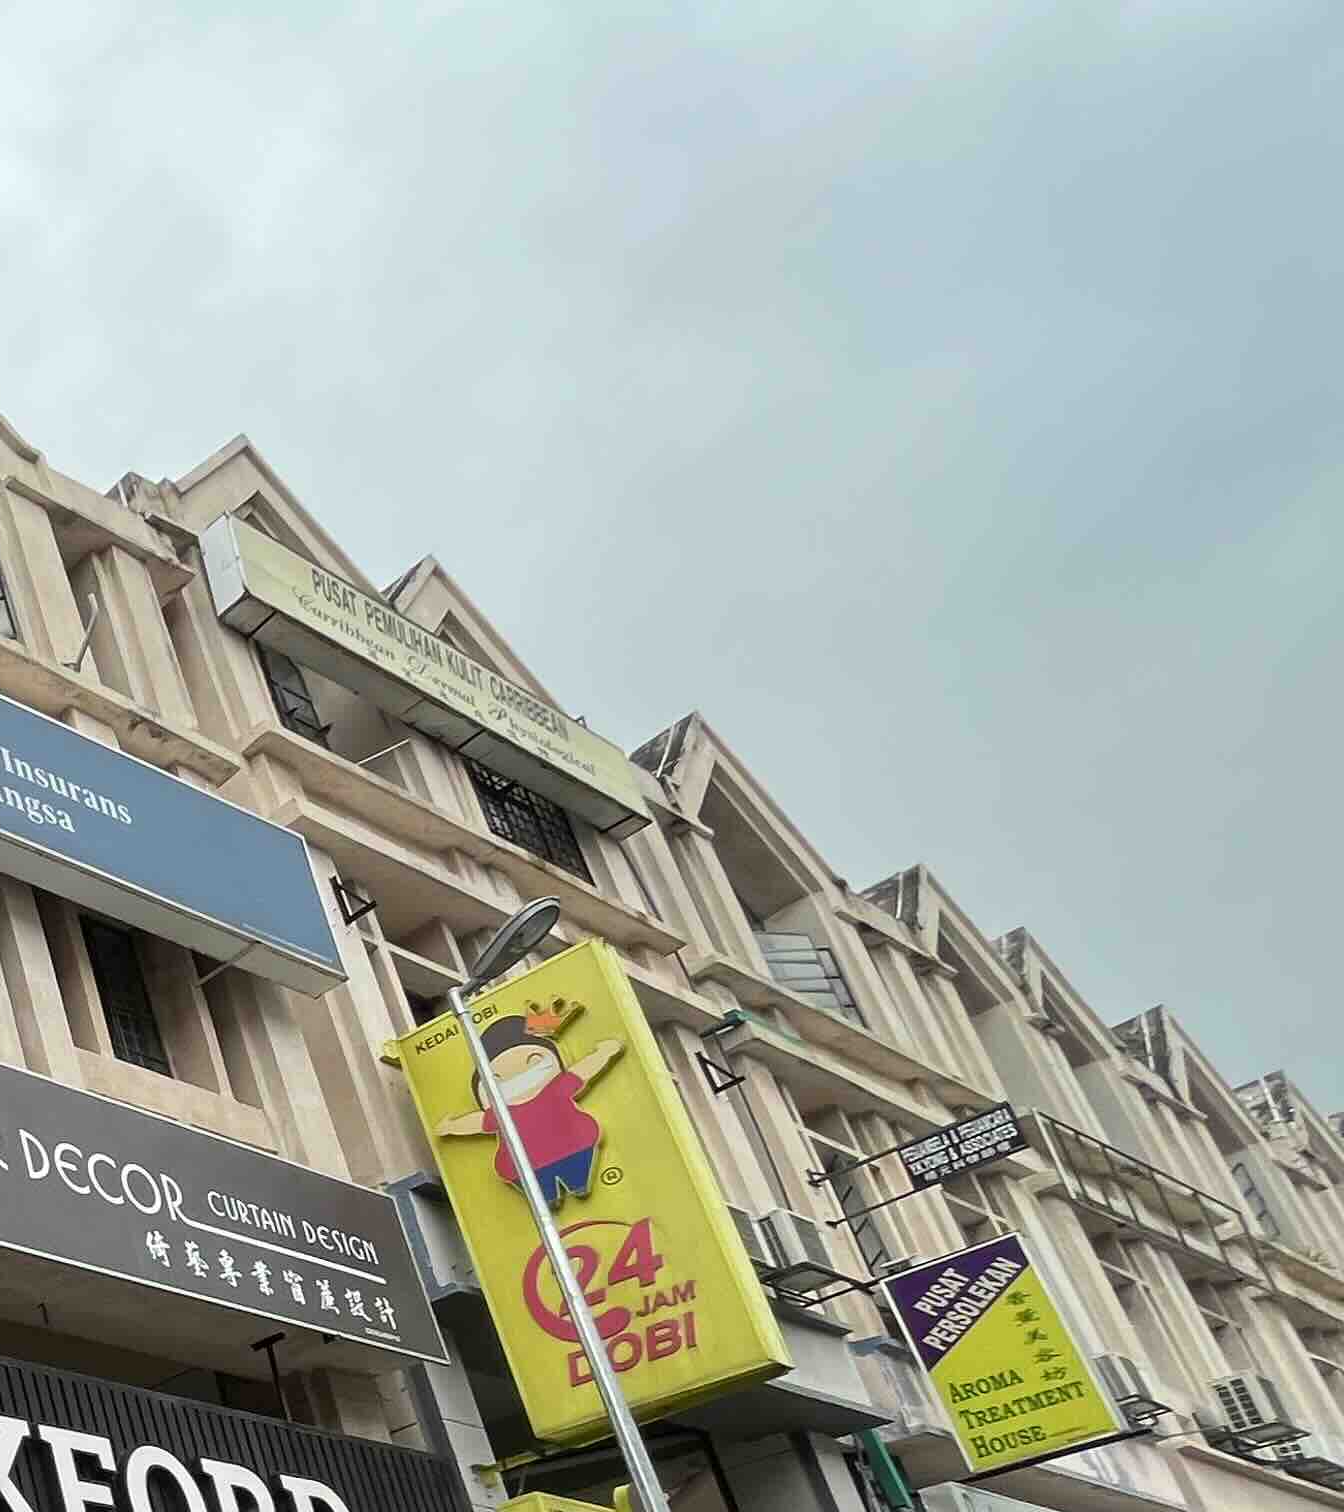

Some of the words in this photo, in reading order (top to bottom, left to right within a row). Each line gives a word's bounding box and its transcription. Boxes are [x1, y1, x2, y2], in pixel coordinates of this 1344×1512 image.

[311, 569, 360, 617] PUSAT
[363, 598, 443, 669] PEMULIHAN
[446, 648, 485, 692] KULIT
[0, 745, 133, 826] Insurans
[414, 1023, 460, 1056] KEDAI
[470, 1002, 500, 1026] OBI
[17, 1128, 192, 1223] DECOR
[207, 1189, 297, 1240] CURTAIN
[302, 1219, 380, 1265] DESIGN
[540, 1216, 665, 1330] 24
[634, 1279, 698, 1320] JAM
[912, 1266, 971, 1318] PUSAT
[920, 1255, 1024, 1352] PERSOLEKAN
[947, 1369, 1025, 1405] AROMA
[958, 1380, 1087, 1431] TREATMENT
[969, 1425, 1048, 1459] HOUSE
